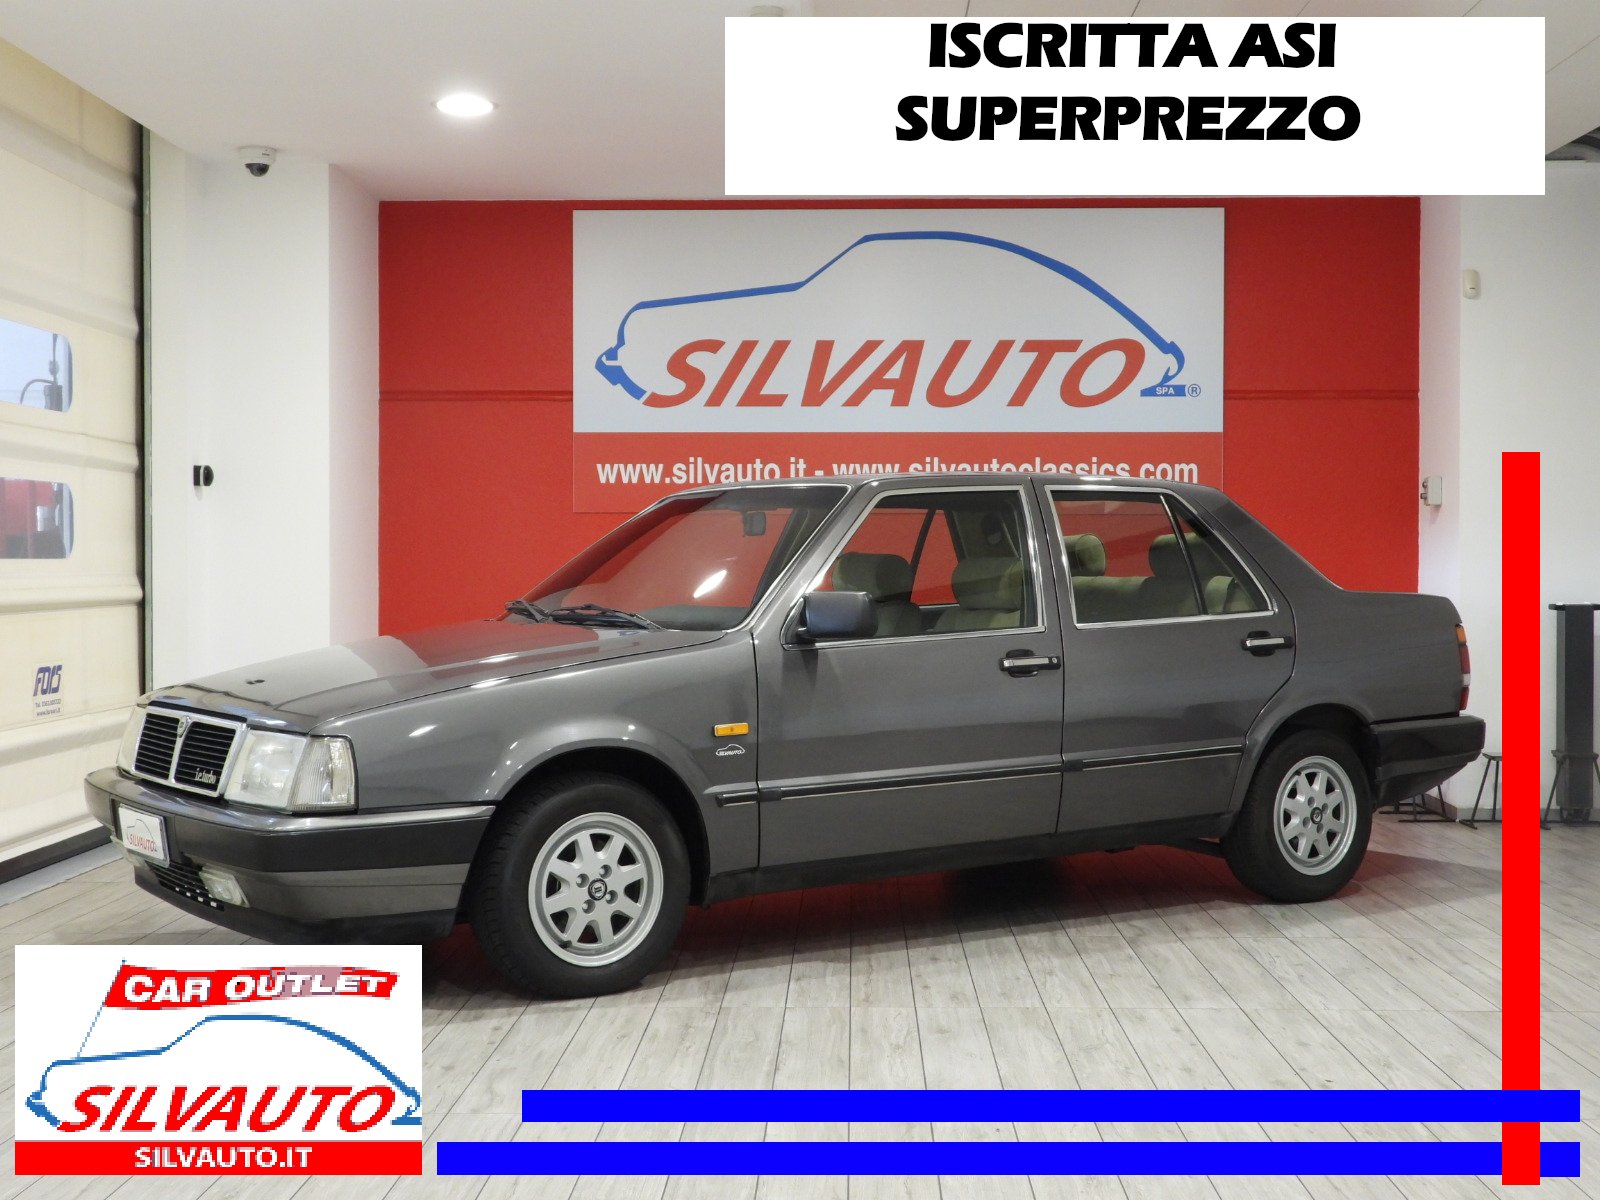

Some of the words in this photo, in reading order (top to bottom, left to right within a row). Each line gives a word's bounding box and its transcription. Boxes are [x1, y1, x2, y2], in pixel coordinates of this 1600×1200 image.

[642, 338, 1146, 408] SILVAUTO
[1155, 386, 1175, 395] SPA
[596, 457, 807, 484] www.silvautoit
